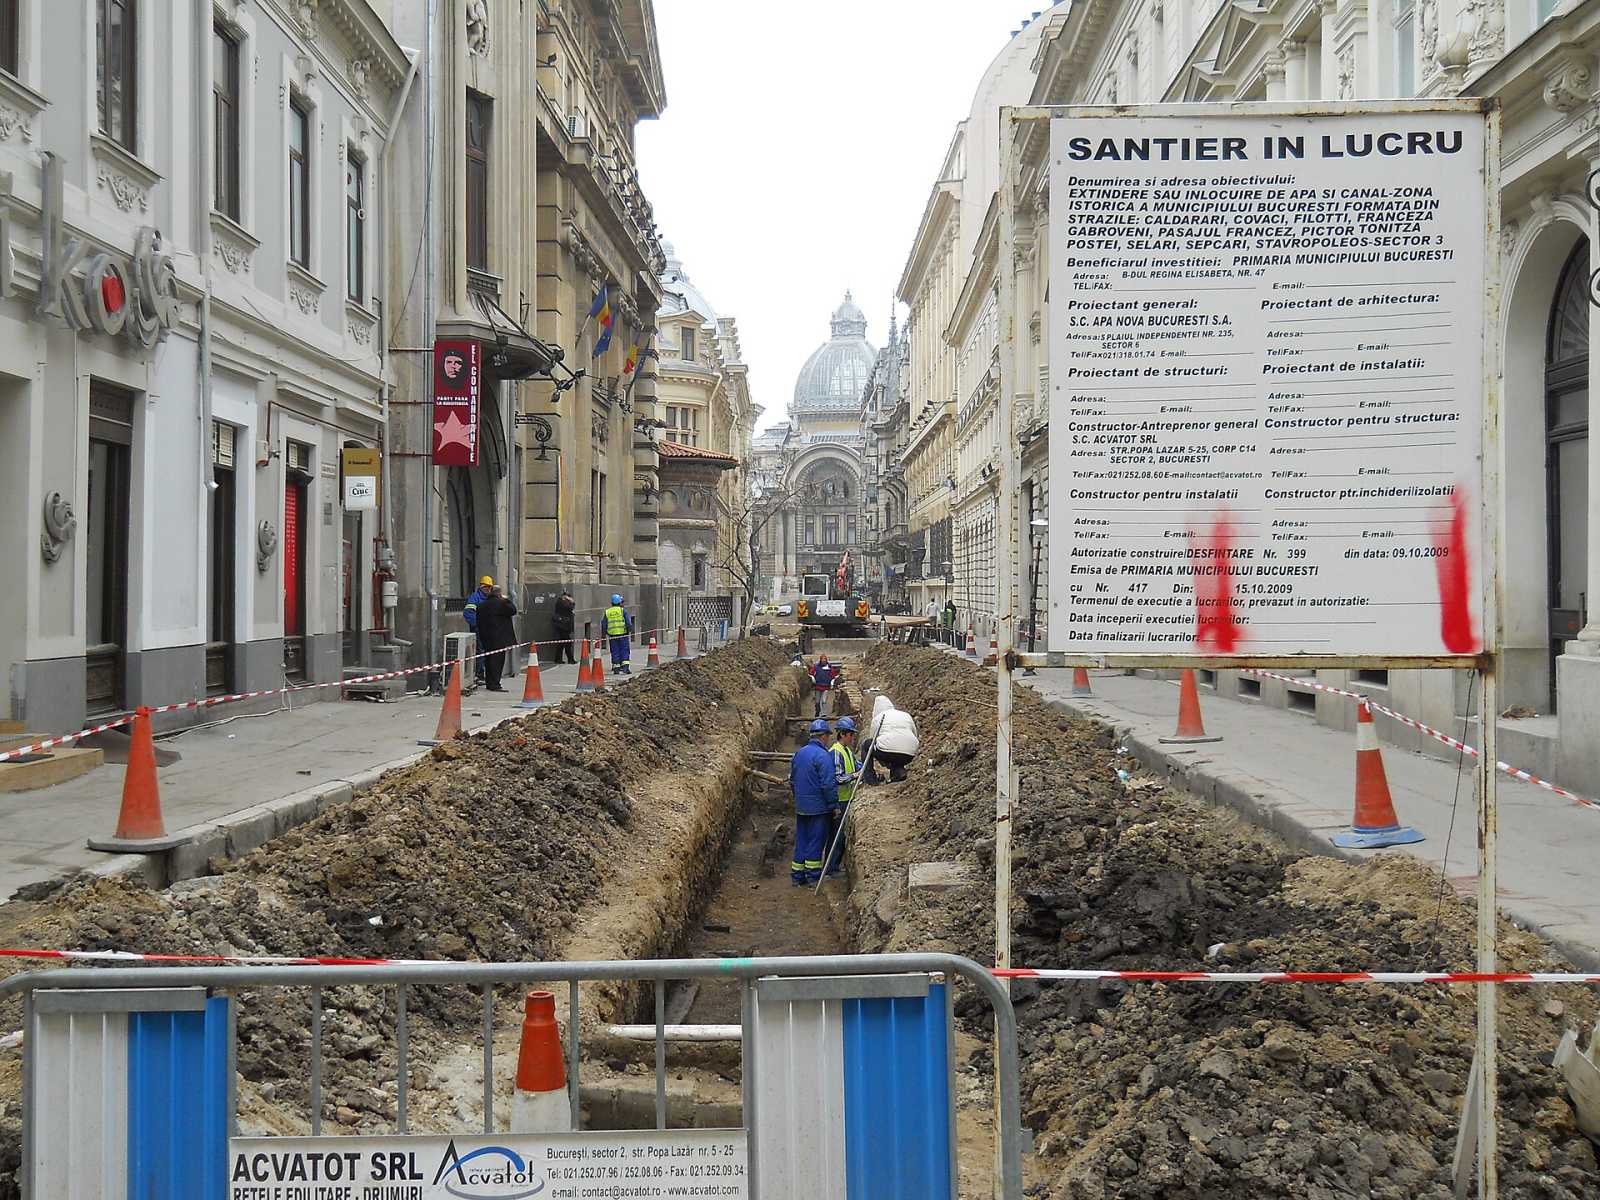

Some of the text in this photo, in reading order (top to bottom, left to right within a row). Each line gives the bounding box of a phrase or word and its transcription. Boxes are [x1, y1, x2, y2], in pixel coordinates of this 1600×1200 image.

[1068, 130, 1462, 161] SANTIER IN LUCRU
[1068, 174, 1296, 187] Denumirea si adresa obiectivului:
[1069, 187, 1433, 200] EXTINDERE SAU INLOCUIRE DE APA SI CANAL-ZONA
[1068, 199, 1440, 213] ISTORICA A MUNICIPIULUI BUCURESTI FORMATA DIN
[1068, 211, 1433, 226] STRAZILE: CALDARARI, COVACI, FILOTTI, FRANCEZA
[1068, 222, 1421, 240] GABROVENI, PASAJUL FRANCEZ, PICTOR TONITZA
[1066, 235, 1444, 252] POSTEI, SELARI, SEPCARI, STAVROPOLEOS-SECTOR 3
[1067, 249, 1454, 268] Beneficiarul investitiei: PRIMARIA MUNICIPIULUI BUCURESTI
[1122, 270, 1147, 279] B-DUL
[1150, 270, 1183, 279] REGINA
[1185, 269, 1235, 278] ELISABETA,
[1237, 269, 1252, 277] NR.
[1254, 268, 1266, 276] 47
[1068, 298, 1198, 312] Proiectant general:
[1261, 294, 1440, 310] Proiectant de arhitectura:
[1069, 314, 1232, 327] S.C. APA NOVA BUCURESTI S.A.
[1065, 333, 1101, 341] Adresa:
[1136, 331, 1200, 340] INDEPENDENTEI
[1218, 329, 1234, 338] 235,
[1102, 341, 1133, 349] SECTOR
[1068, 365, 1228, 378] Proiectant de structuri:
[1262, 358, 1425, 374] Proiectant de instalatii:
[1068, 418, 1258, 433] Constructor-Antreprenor general
[1264, 413, 1460, 428] Constructor pentru structura:
[1072, 434, 1158, 444] S.C. ACVATOT SRL
[1156, 446, 1186, 454] LAZAR
[1188, 445, 1209, 454] 5-25,
[1212, 445, 1237, 453] CORP
[1239, 445, 1256, 453] C14
[1110, 455, 1211, 465] SECTOR 2, BUCURESTI
[1070, 488, 1238, 502] Constructor pentru instalatii
[1264, 489, 1337, 499] Constructor
[1070, 547, 1127, 558] Autorizatie
[1263, 549, 1277, 559] Nr.
[1287, 548, 1306, 559] 399
[1344, 548, 1360, 559] din
[1363, 548, 1390, 559] data:
[1392, 547, 1449, 558] 09.10.2009
[1070, 564, 1319, 576] Emisa de PRIMARIA MUNICIPIULUI BUCURESTI
[1095, 582, 1109, 593] Nr.
[1128, 583, 1148, 593] 417
[1173, 583, 1194, 594] Din:
[1235, 583, 1293, 594] 15.10.2009
[1070, 594, 1369, 609] Termenul de executie a lucrilor, prevazut in autorizatie:
[1069, 612, 1250, 626] Data inceperii executiei lucrilor:
[1069, 630, 1199, 642] Data finalizarii lucrarilor:
[591, 1147, 618, 1159] sector
[620, 1146, 627, 1158] 2,
[632, 1147, 645, 1158] str.
[647, 1146, 669, 1160] Popa
[698, 1147, 709, 1157] nr.
[711, 1144, 717, 1157] 5
[724, 1144, 734, 1156] 25
[232, 1152, 424, 1182] ACVATOT SRL
[546, 1164, 744, 1180] Tel: 021.252.07.96 252.08.06 Fax: 021.252.09.34
[552, 1186, 579, 1199] e-mail:
[667, 1184, 739, 1197] www.acvatot.com
